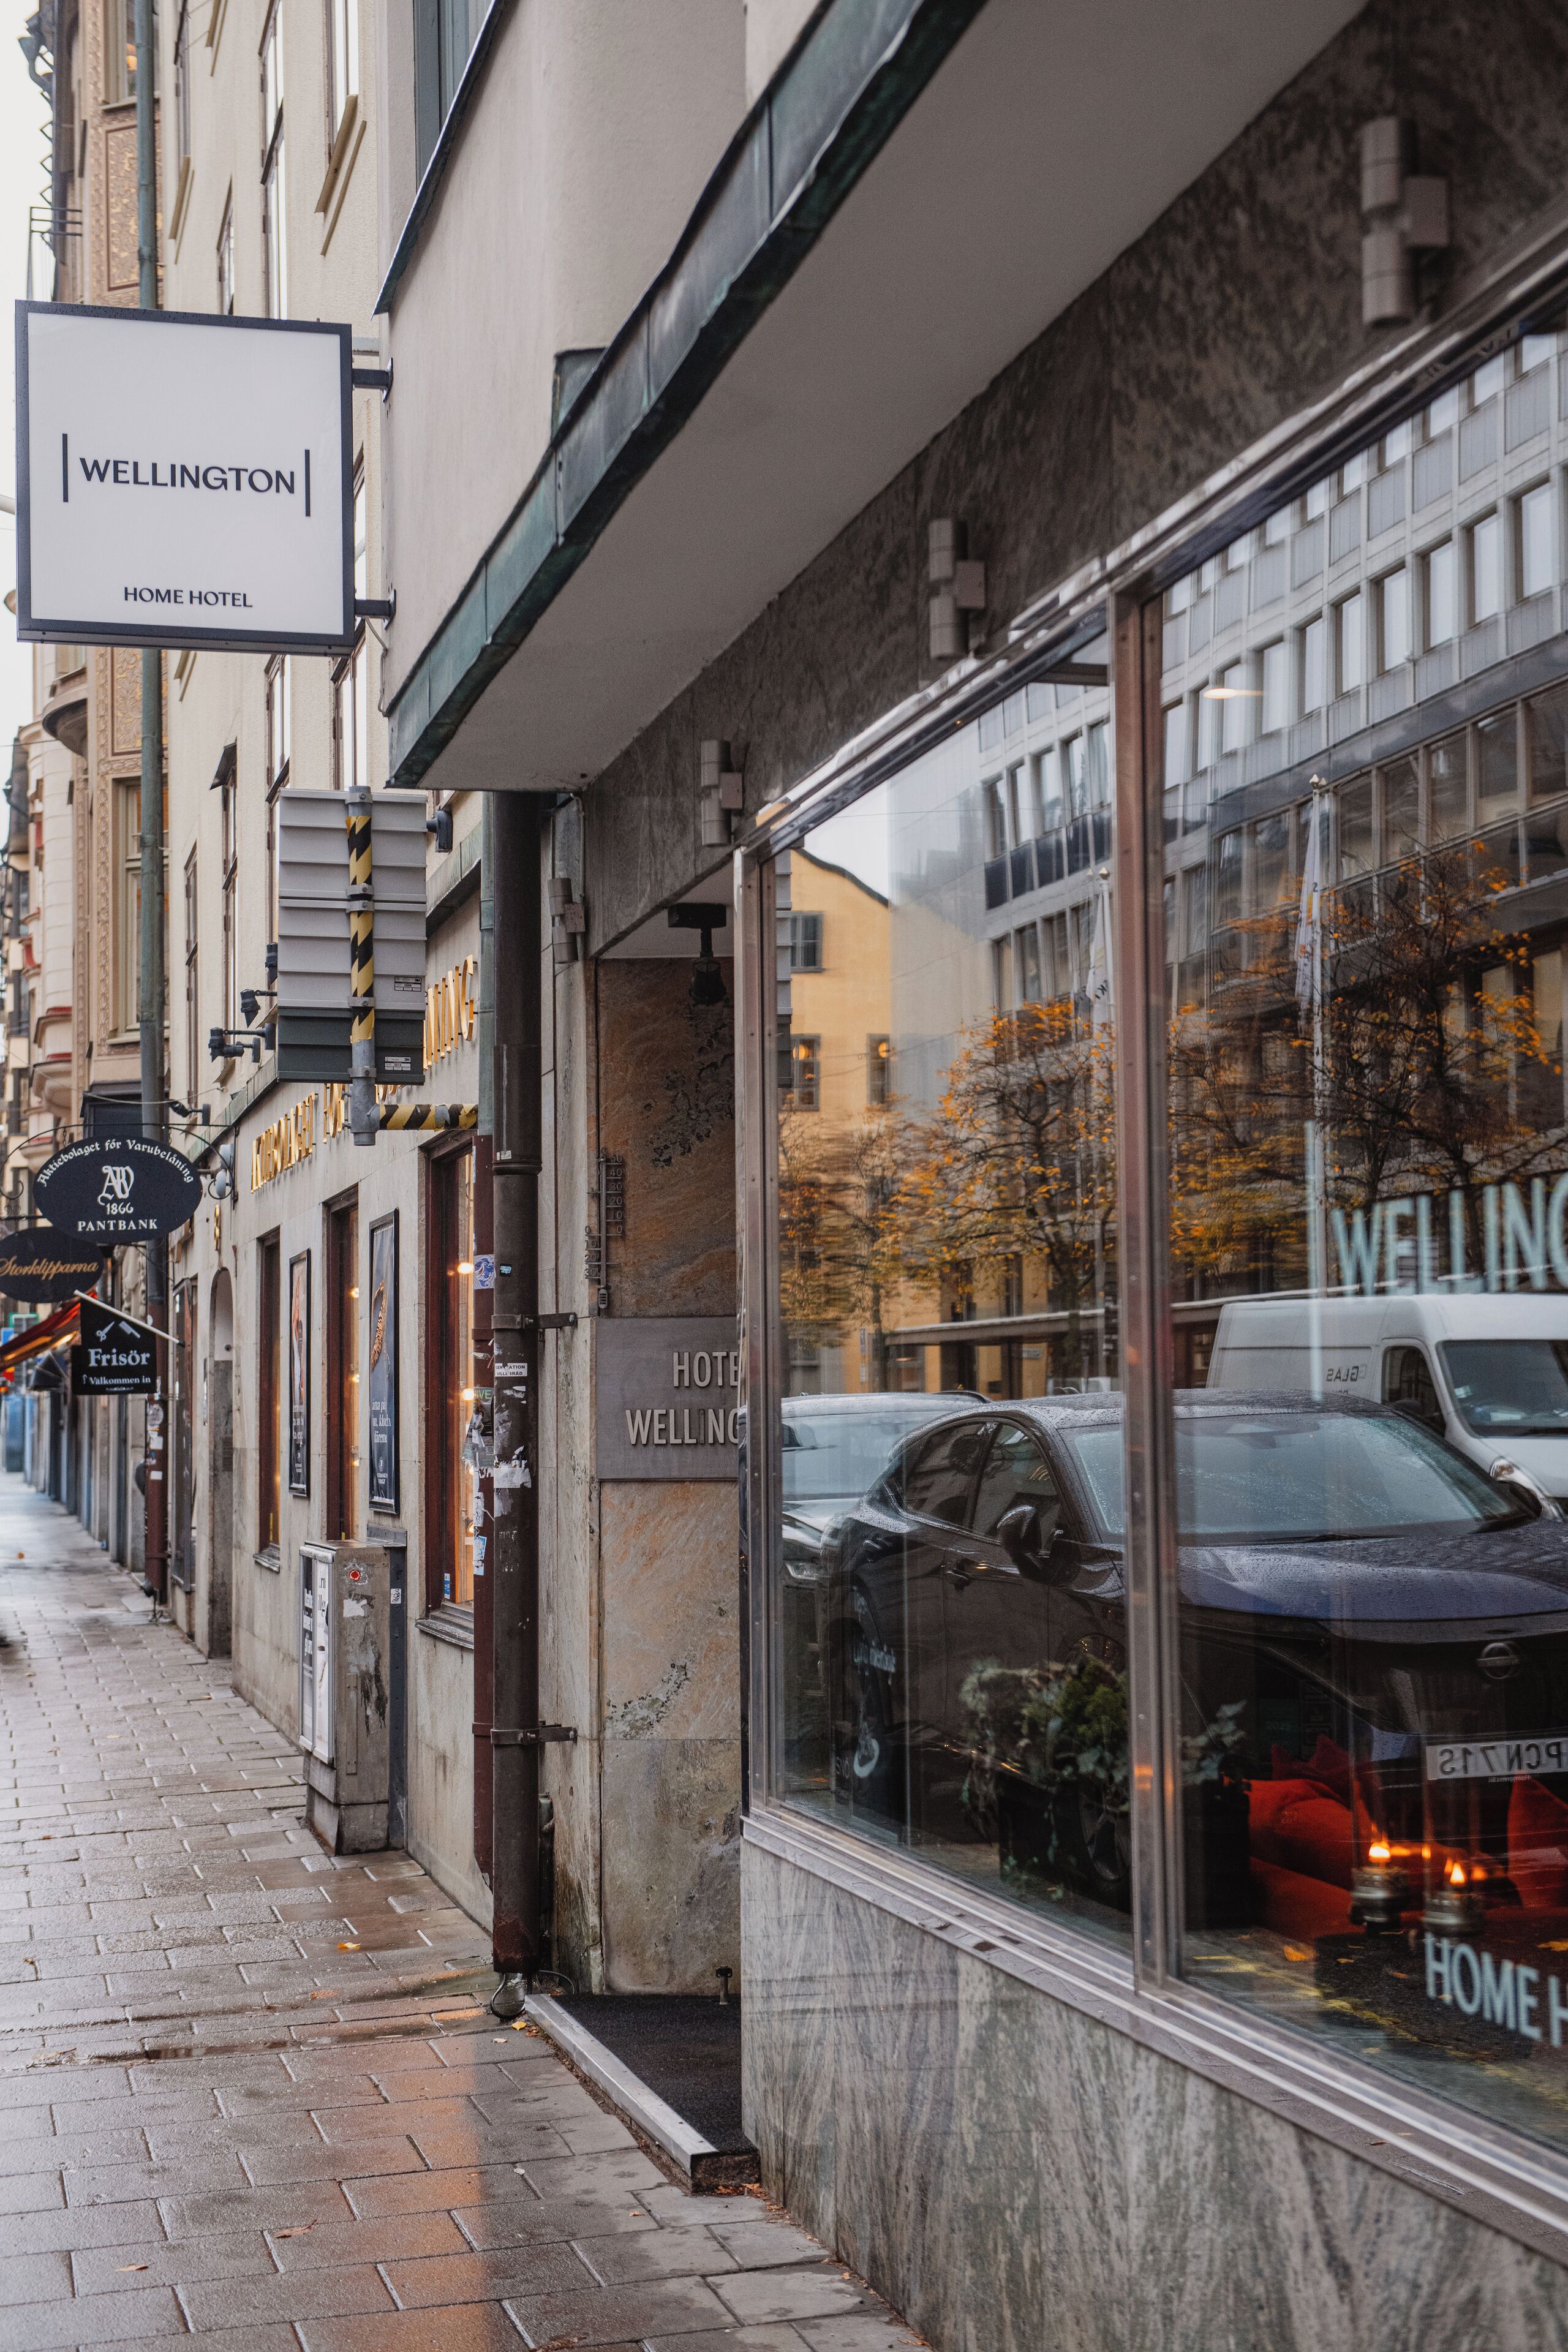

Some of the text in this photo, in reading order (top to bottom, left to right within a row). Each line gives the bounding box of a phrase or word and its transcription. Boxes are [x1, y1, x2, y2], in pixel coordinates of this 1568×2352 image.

[79, 457, 295, 495] WELLINGTON
[124, 586, 253, 608] HOME HOTEL
[36, 1138, 194, 1187] Aktiebolaget för Varubelåning
[609, 1169, 622, 1177] 40
[611, 1182, 622, 1191] 30
[106, 1202, 134, 1215] 1866
[611, 1196, 622, 1205] 20
[77, 1218, 158, 1232] PANTBANK
[0, 1255, 99, 1281] Storklipparna
[88, 1348, 151, 1367] Frisör
[89, 1375, 151, 1385] Välkommen in
[1423, 1931, 1542, 2041] HOME
